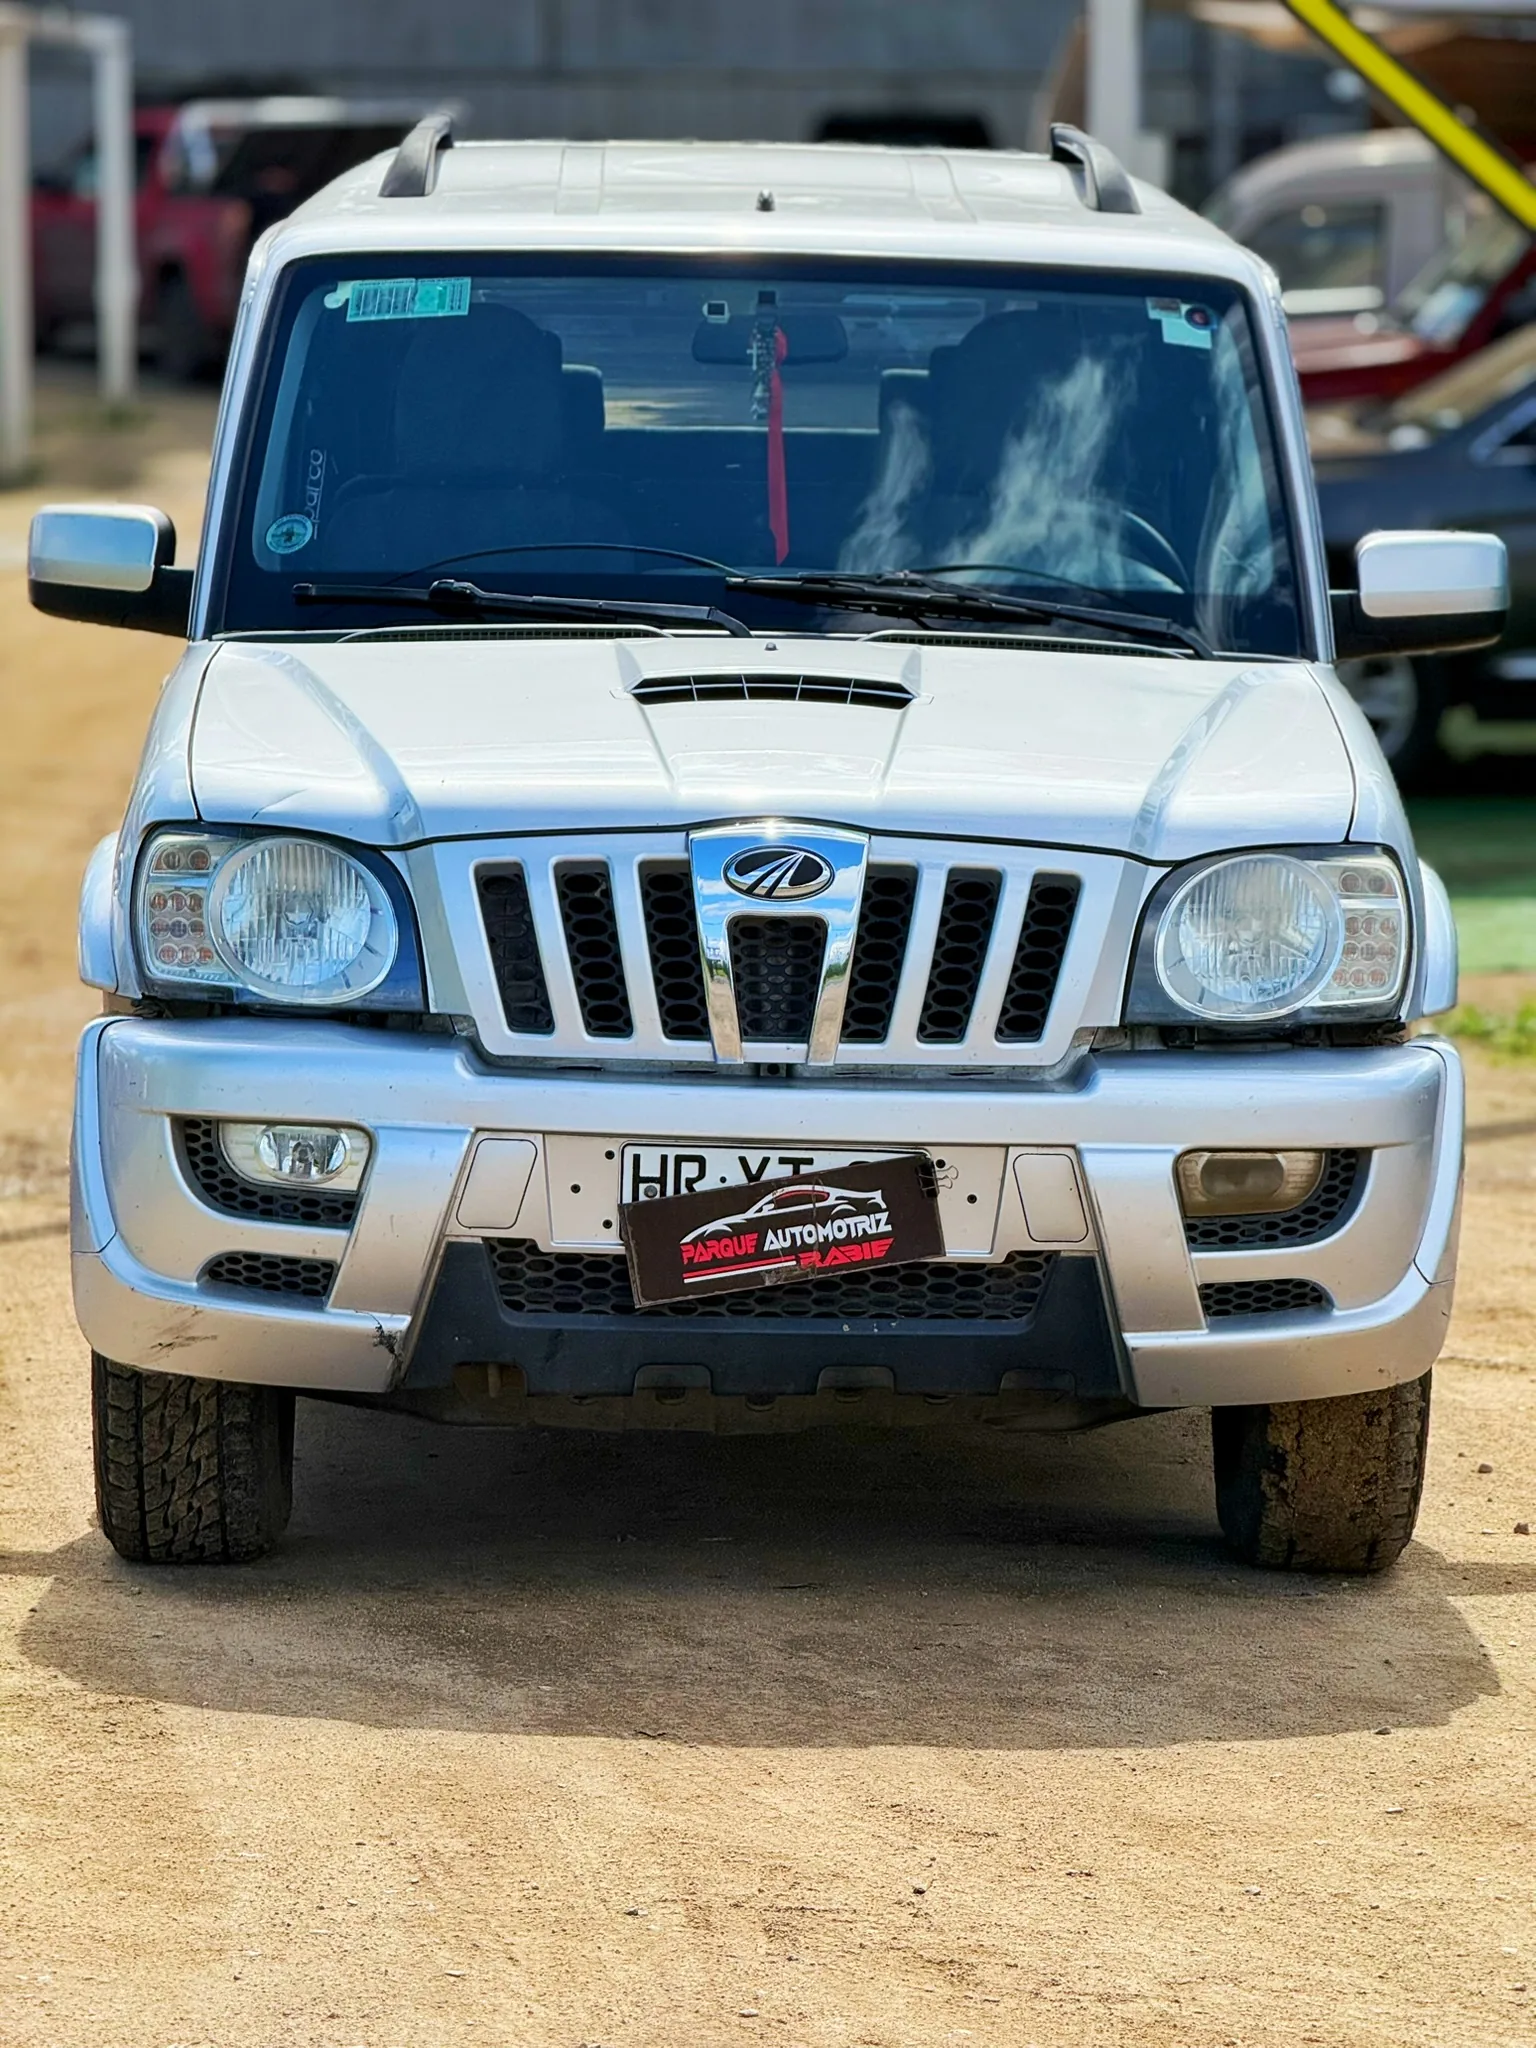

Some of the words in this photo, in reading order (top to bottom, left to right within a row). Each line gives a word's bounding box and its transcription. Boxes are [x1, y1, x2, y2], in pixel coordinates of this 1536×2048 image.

[303, 448, 324, 523] parco
[680, 1233, 758, 1265] PARQUE
[763, 1211, 892, 1251] AUTOMOTRIZ
[799, 1237, 896, 1270] RABIE
